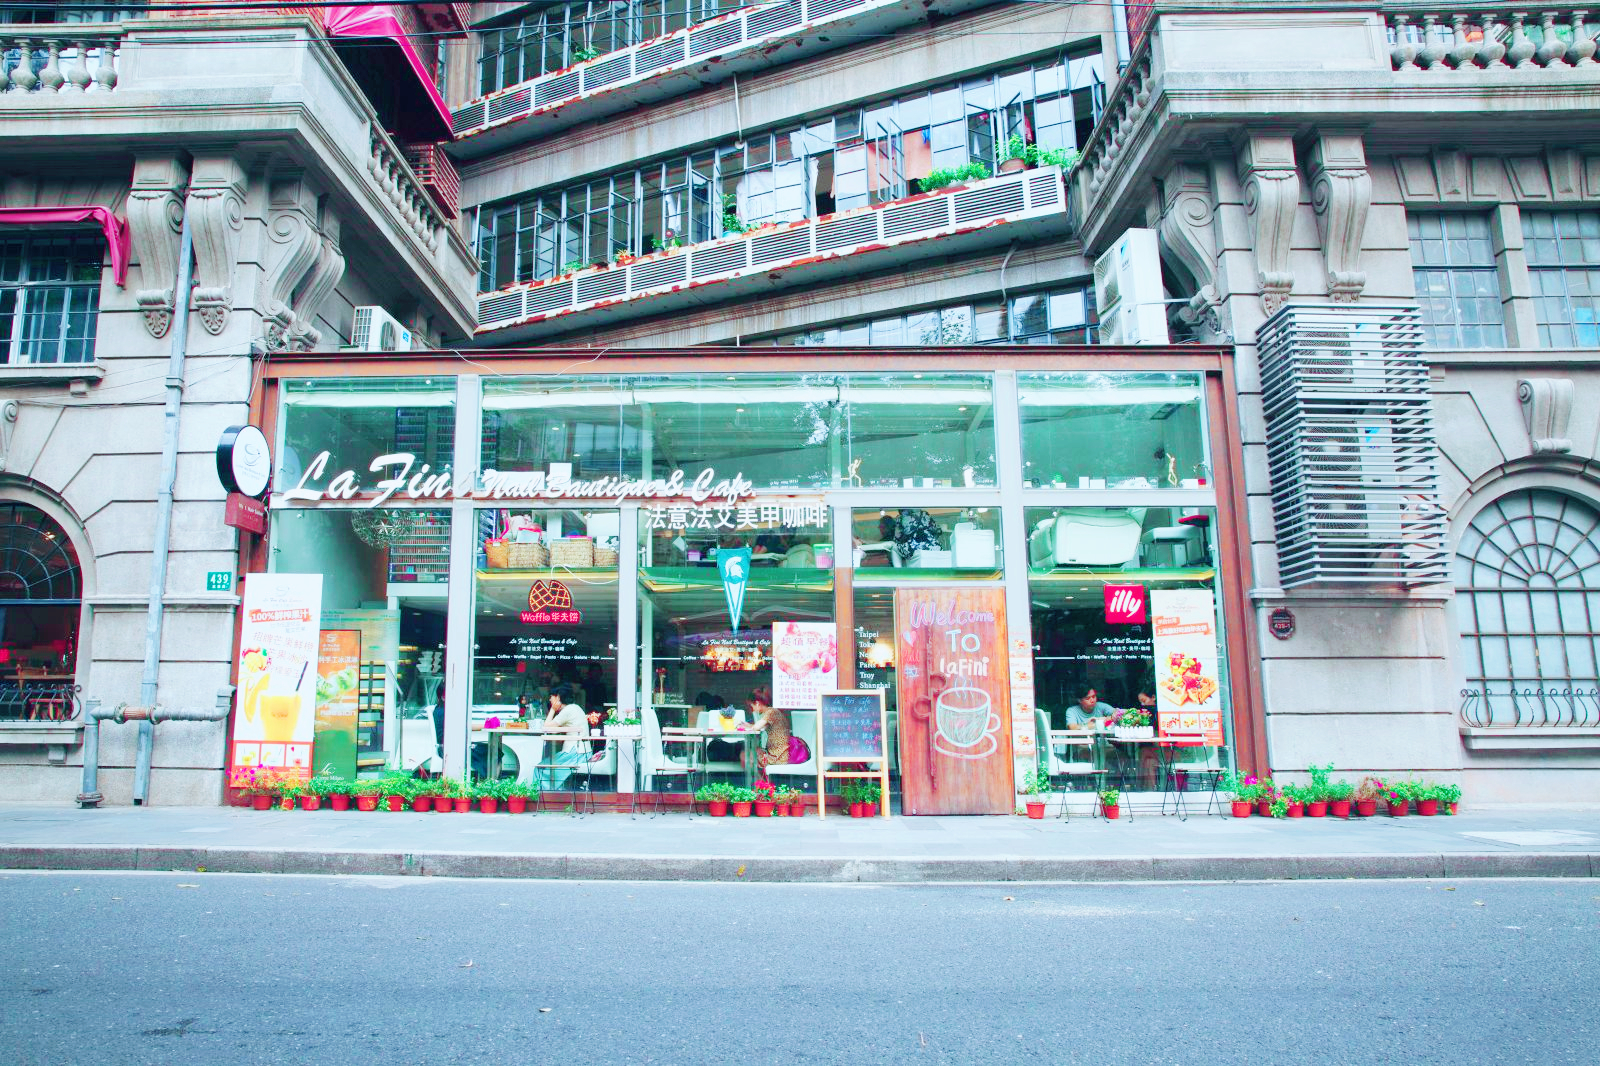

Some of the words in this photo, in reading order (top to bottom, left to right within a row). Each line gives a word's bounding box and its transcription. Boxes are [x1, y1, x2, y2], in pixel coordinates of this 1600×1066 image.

[281, 450, 360, 501] La
[369, 452, 476, 508] Fini
[482, 470, 541, 499] Nail
[665, 470, 684, 497] &
[645, 503, 828, 529] 法意法艾美甲咖啡
[210, 573, 229, 584] 439
[1110, 589, 1141, 618] illy
[551, 612, 579, 622] 华夫饼
[910, 599, 994, 629] Welcome
[859, 631, 879, 639] Taipei
[517, 637, 528, 645] Fini
[945, 629, 980, 653] TO
[1102, 637, 1113, 645] Fini
[860, 671, 875, 680] Troy
[860, 681, 891, 690] Shanghai
